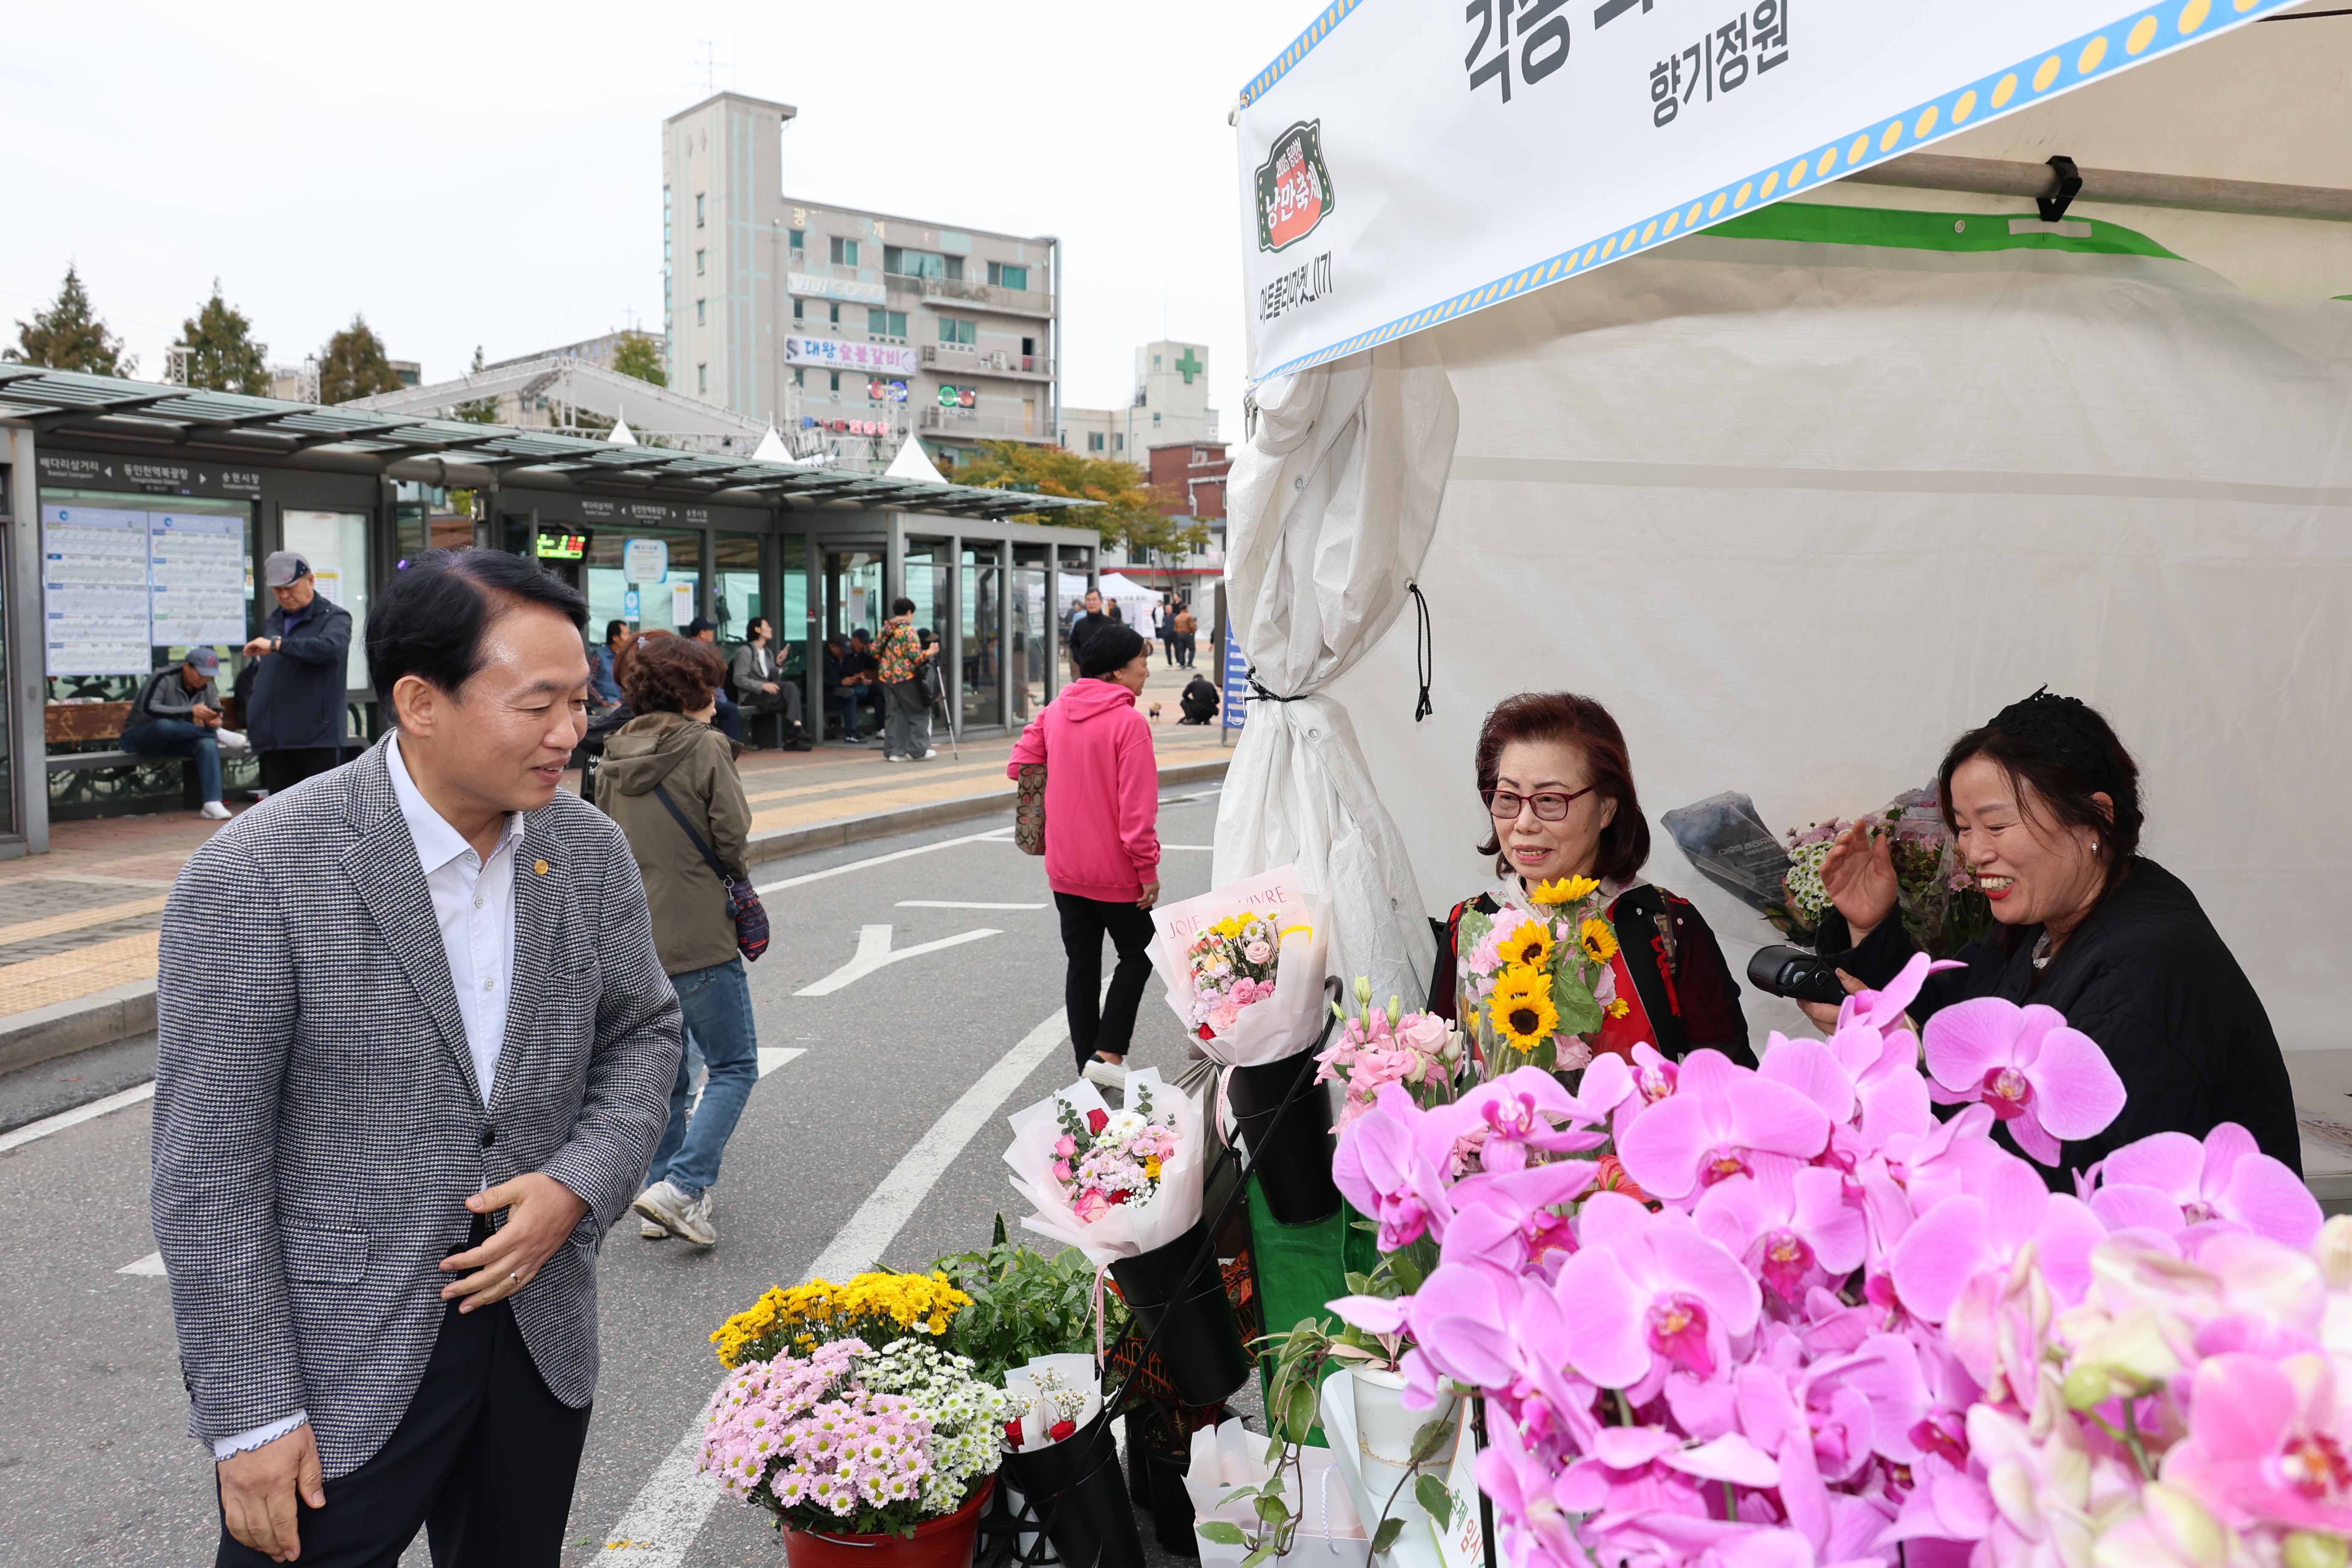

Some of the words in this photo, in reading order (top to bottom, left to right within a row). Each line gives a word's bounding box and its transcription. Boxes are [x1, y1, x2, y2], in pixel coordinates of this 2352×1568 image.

[1650, 0, 1789, 128] 향기정원
[1275, 151, 1289, 178] 2025
[1287, 136, 1303, 165] 동인천
[804, 340, 836, 358] 대왕
[840, 343, 900, 366] 숯불갈비
[1460, 1519, 1484, 1565] 임시
